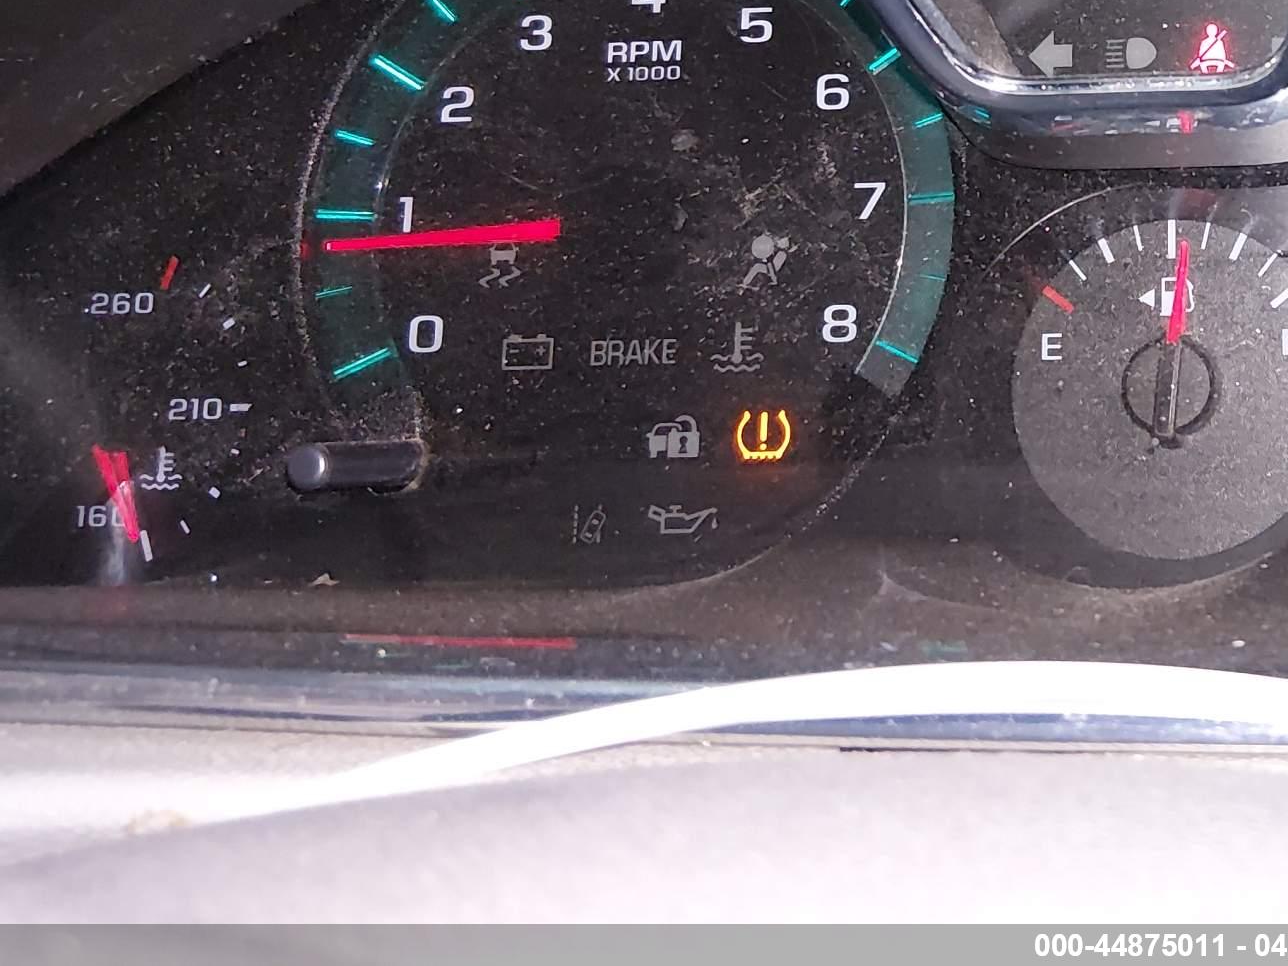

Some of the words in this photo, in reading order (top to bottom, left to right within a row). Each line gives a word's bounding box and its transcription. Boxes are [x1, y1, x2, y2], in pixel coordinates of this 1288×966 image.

[520, 14, 553, 51] 3
[740, 7, 773, 43] 5
[607, 39, 682, 64] RPM
[607, 67, 621, 82] X
[627, 65, 681, 81] 1000
[440, 86, 475, 123] 2
[816, 73, 850, 111] 6
[399, 196, 414, 233] 1
[853, 182, 886, 220] 7
[90, 292, 154, 315] 260
[408, 315, 444, 353] 0
[822, 304, 858, 343] 8
[589, 336, 677, 366] BRAKE
[1041, 332, 1063, 361] E
[168, 397, 223, 421] 210
